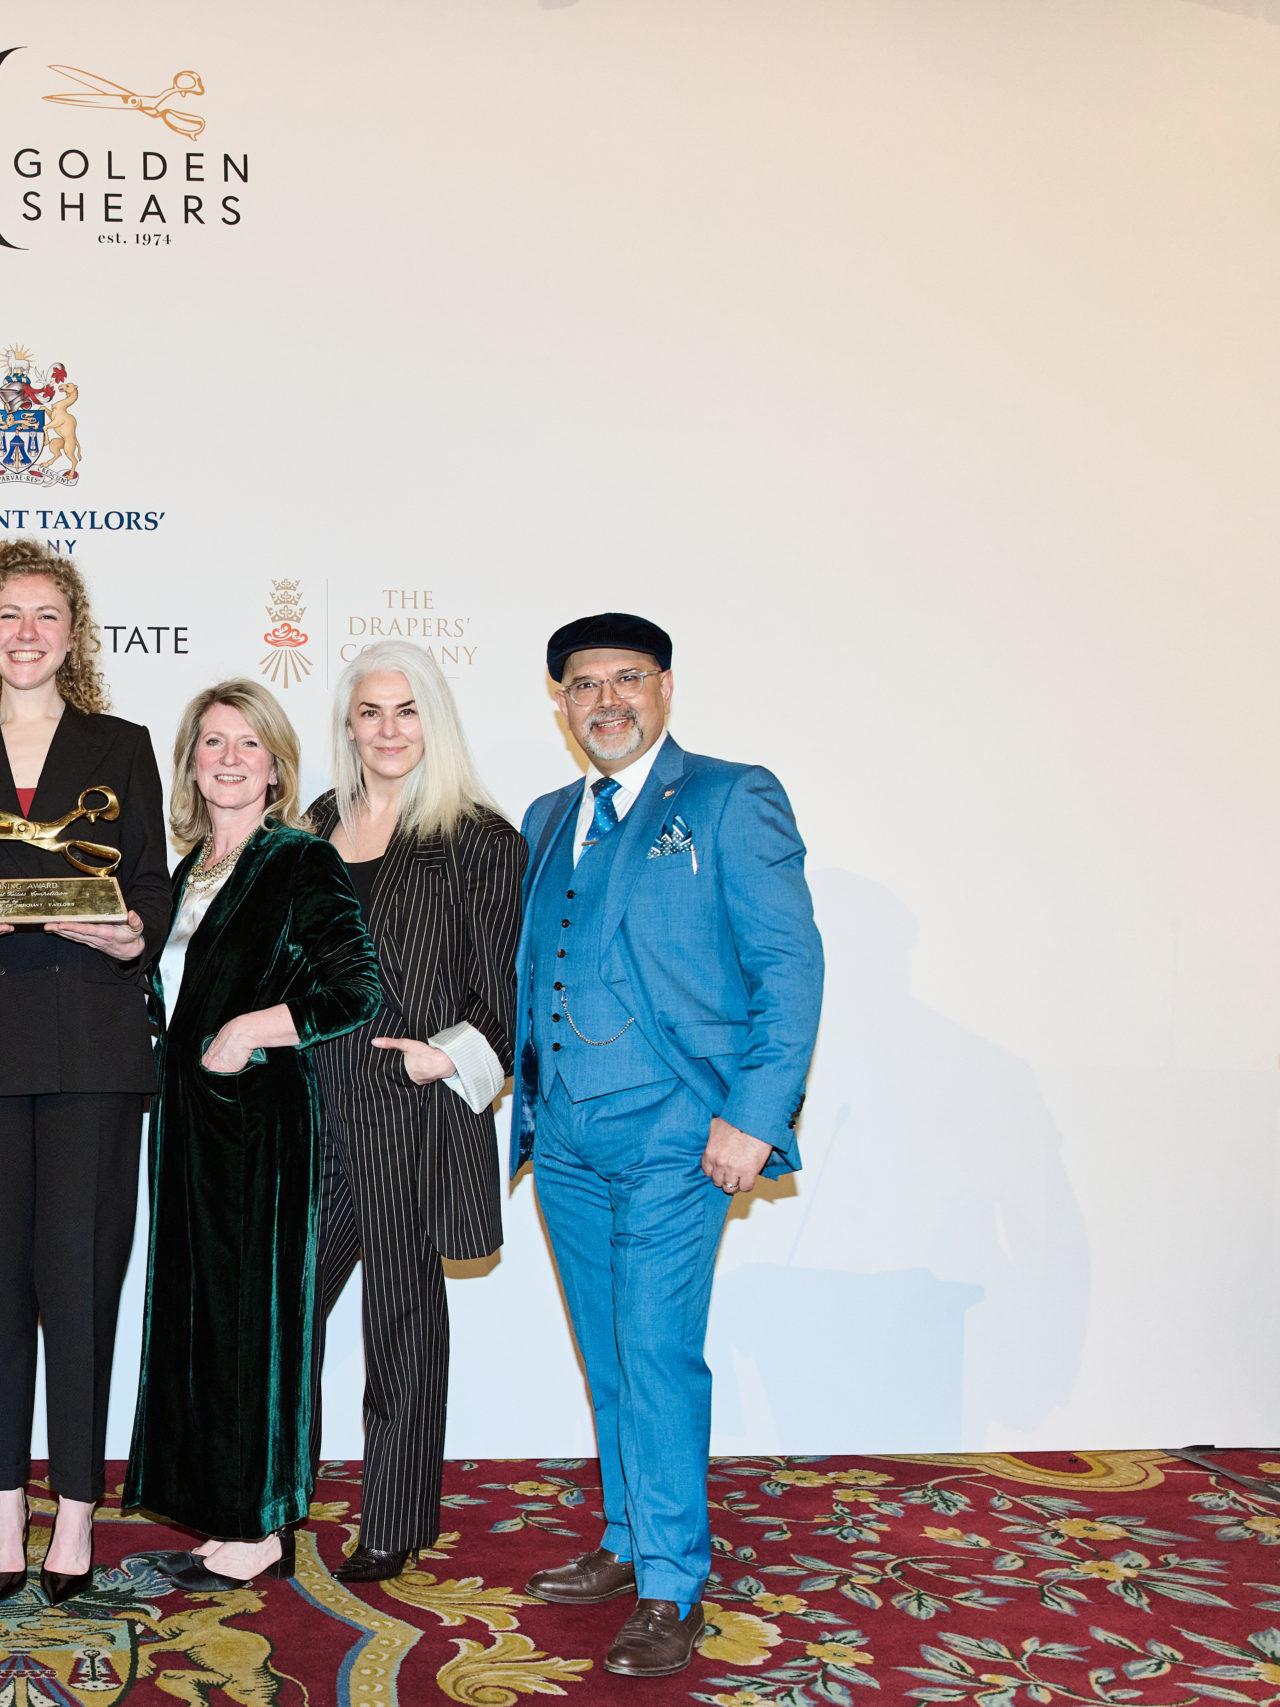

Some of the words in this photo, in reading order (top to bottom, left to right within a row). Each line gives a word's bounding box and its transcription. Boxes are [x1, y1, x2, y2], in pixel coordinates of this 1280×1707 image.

[13, 147, 249, 184] GOLDEN
[22, 190, 242, 226] SHEARS
[97, 232, 128, 245] est.
[134, 232, 172, 247] 1974
[382, 589, 434, 610] THE
[104, 625, 189, 654] TATE
[27, 881, 58, 889] AWARD
